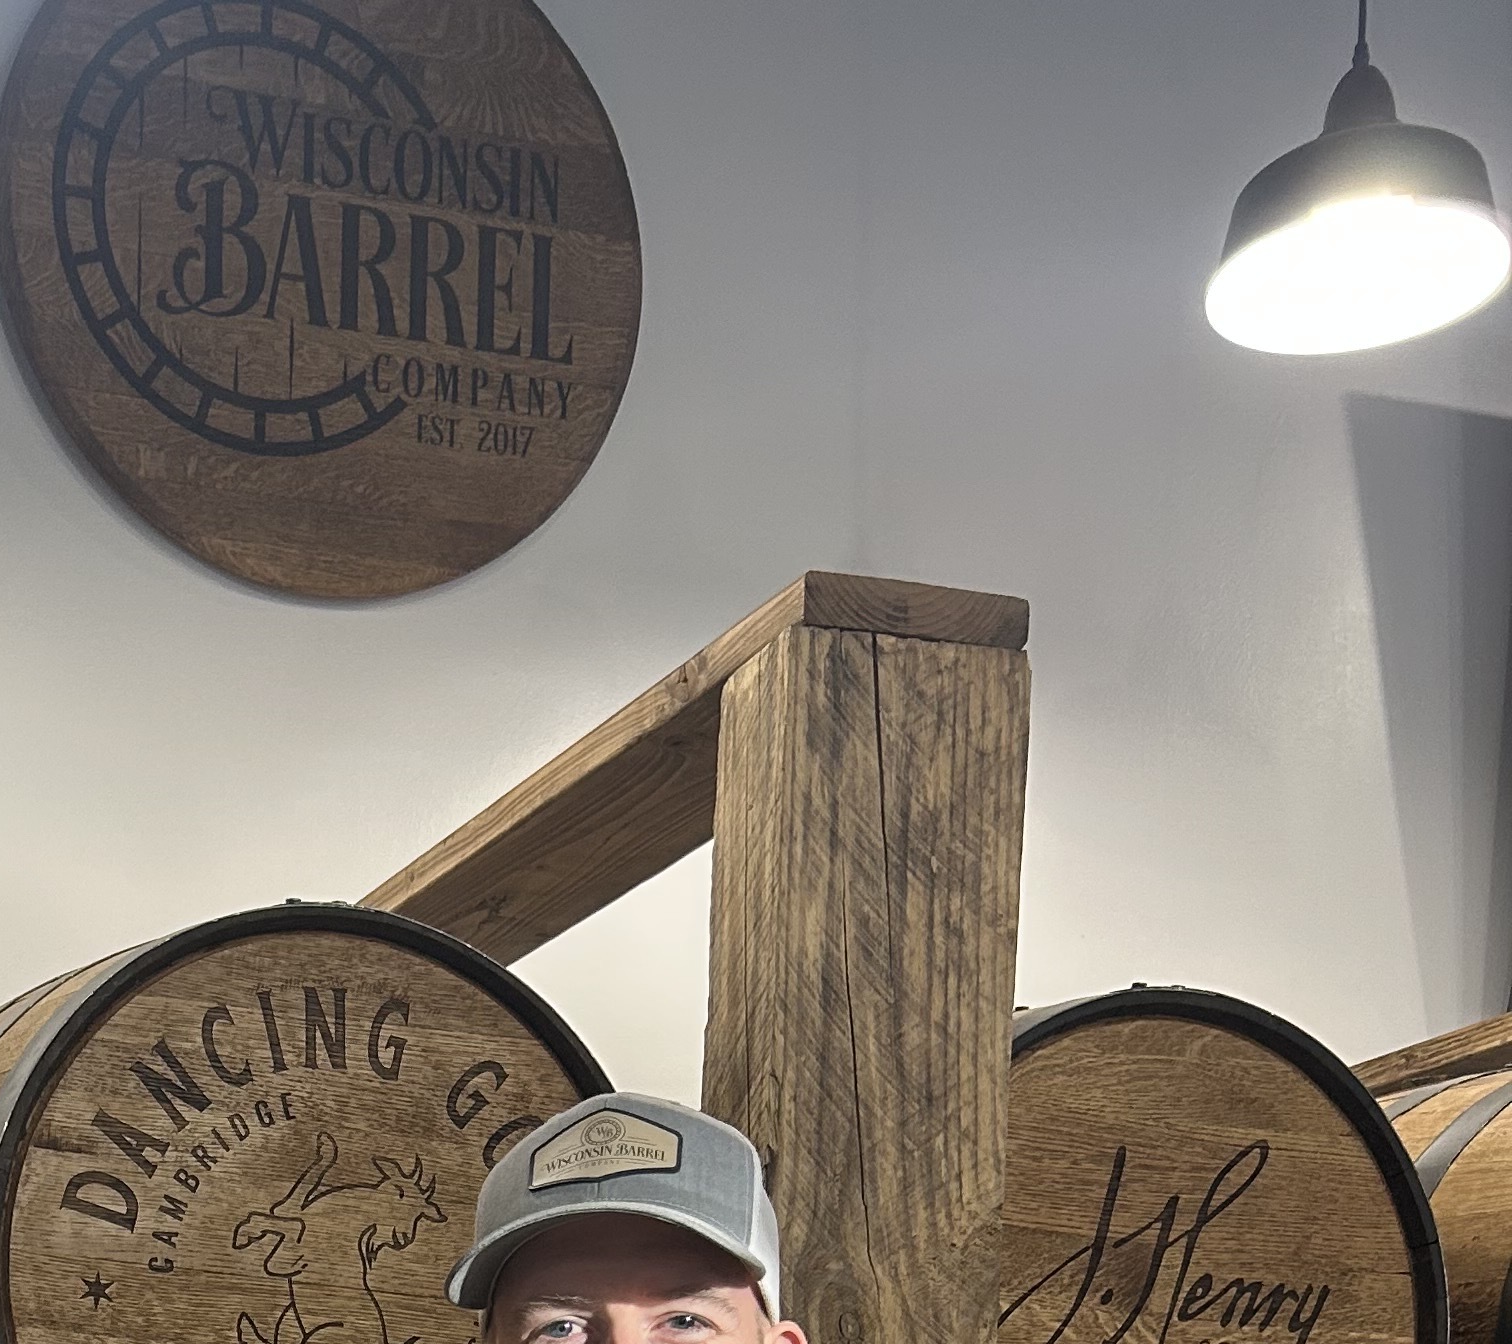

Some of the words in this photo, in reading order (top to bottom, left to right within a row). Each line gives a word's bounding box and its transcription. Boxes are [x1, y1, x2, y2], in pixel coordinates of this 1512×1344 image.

[205, 84, 561, 224] WISCONSIN
[155, 157, 574, 366] BARREL
[371, 353, 574, 420] COMPANY
[477, 420, 536, 458] 2017
[60, 986, 410, 1233] DANCING
[545, 1144, 613, 1174] WISCONSIN
[147, 1092, 297, 1274] CAMBRIDGE
